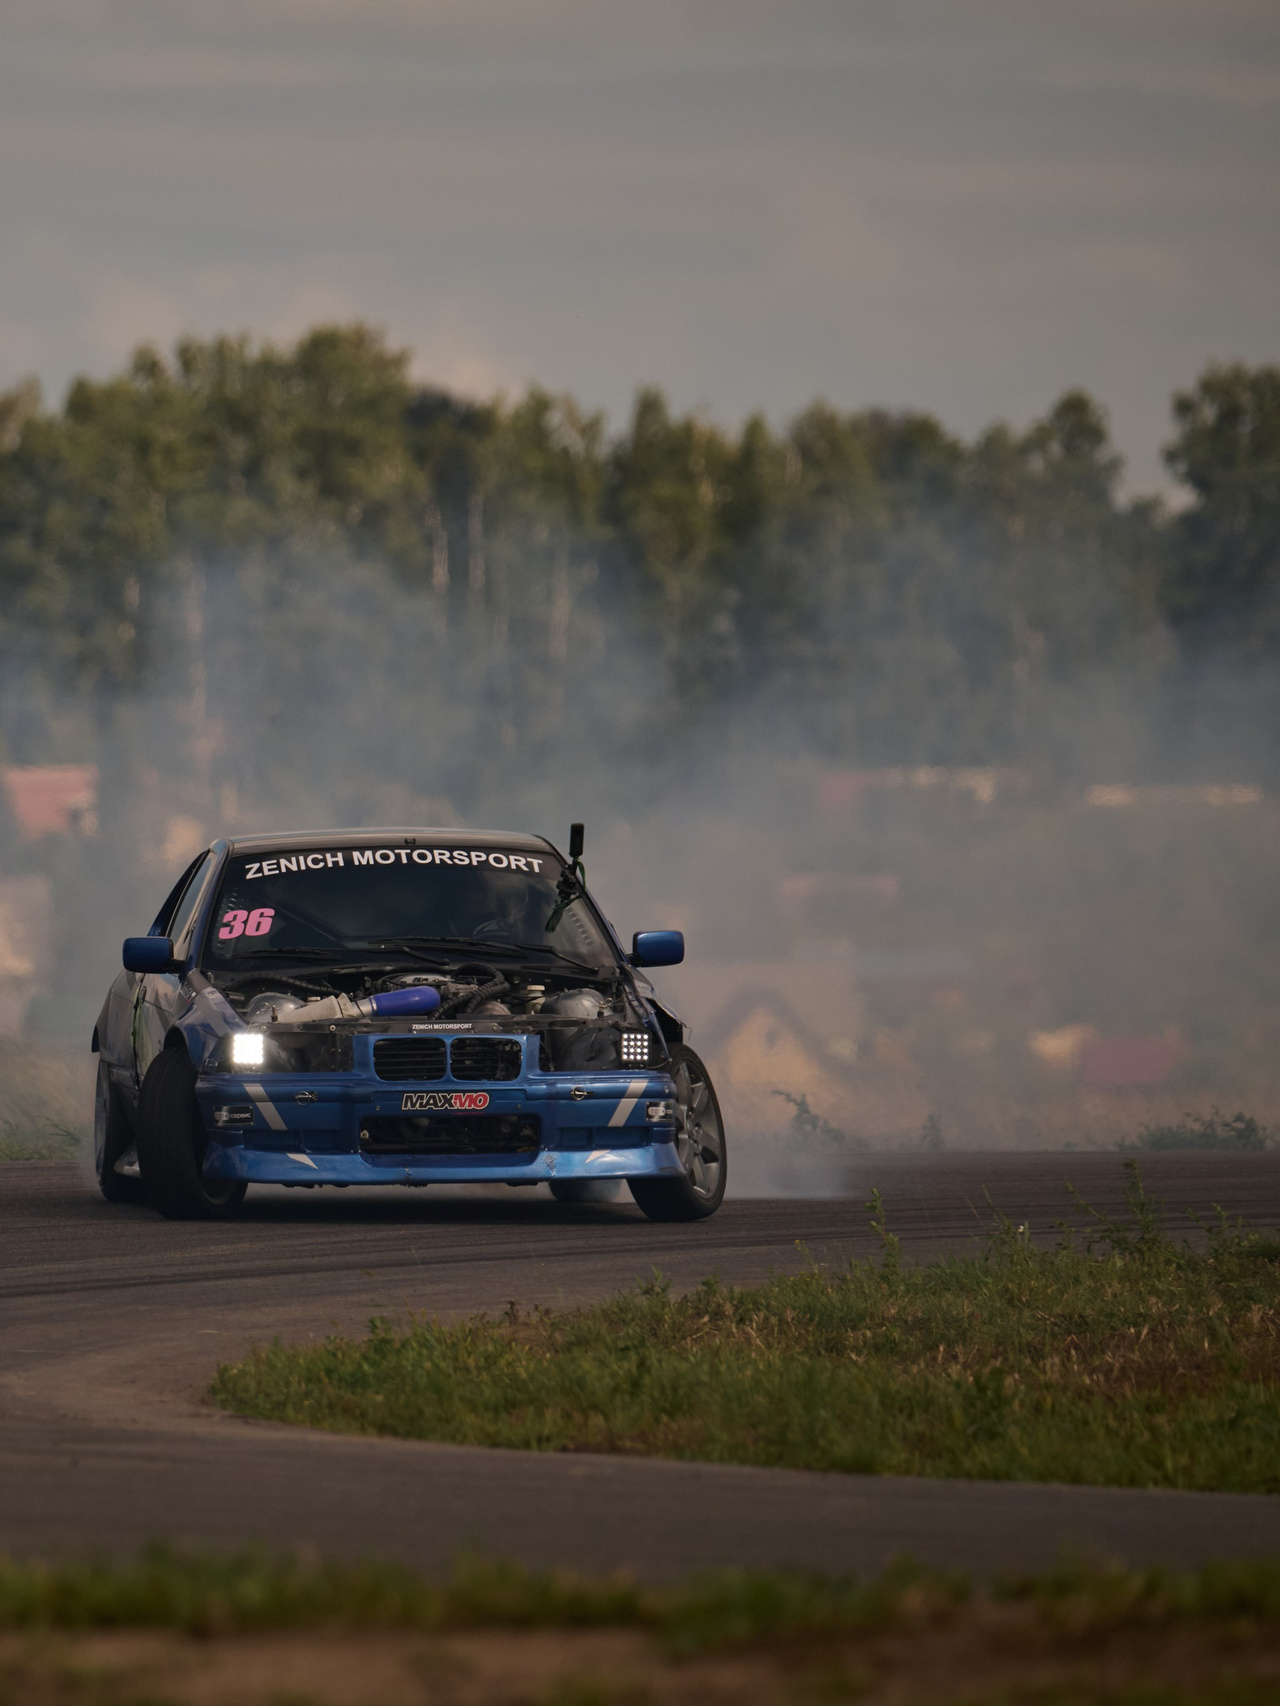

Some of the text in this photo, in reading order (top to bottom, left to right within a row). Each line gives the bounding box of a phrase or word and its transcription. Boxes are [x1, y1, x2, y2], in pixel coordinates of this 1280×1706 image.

[245, 849, 543, 880] ZENICH MOTORSPORT
[218, 907, 276, 940] 36
